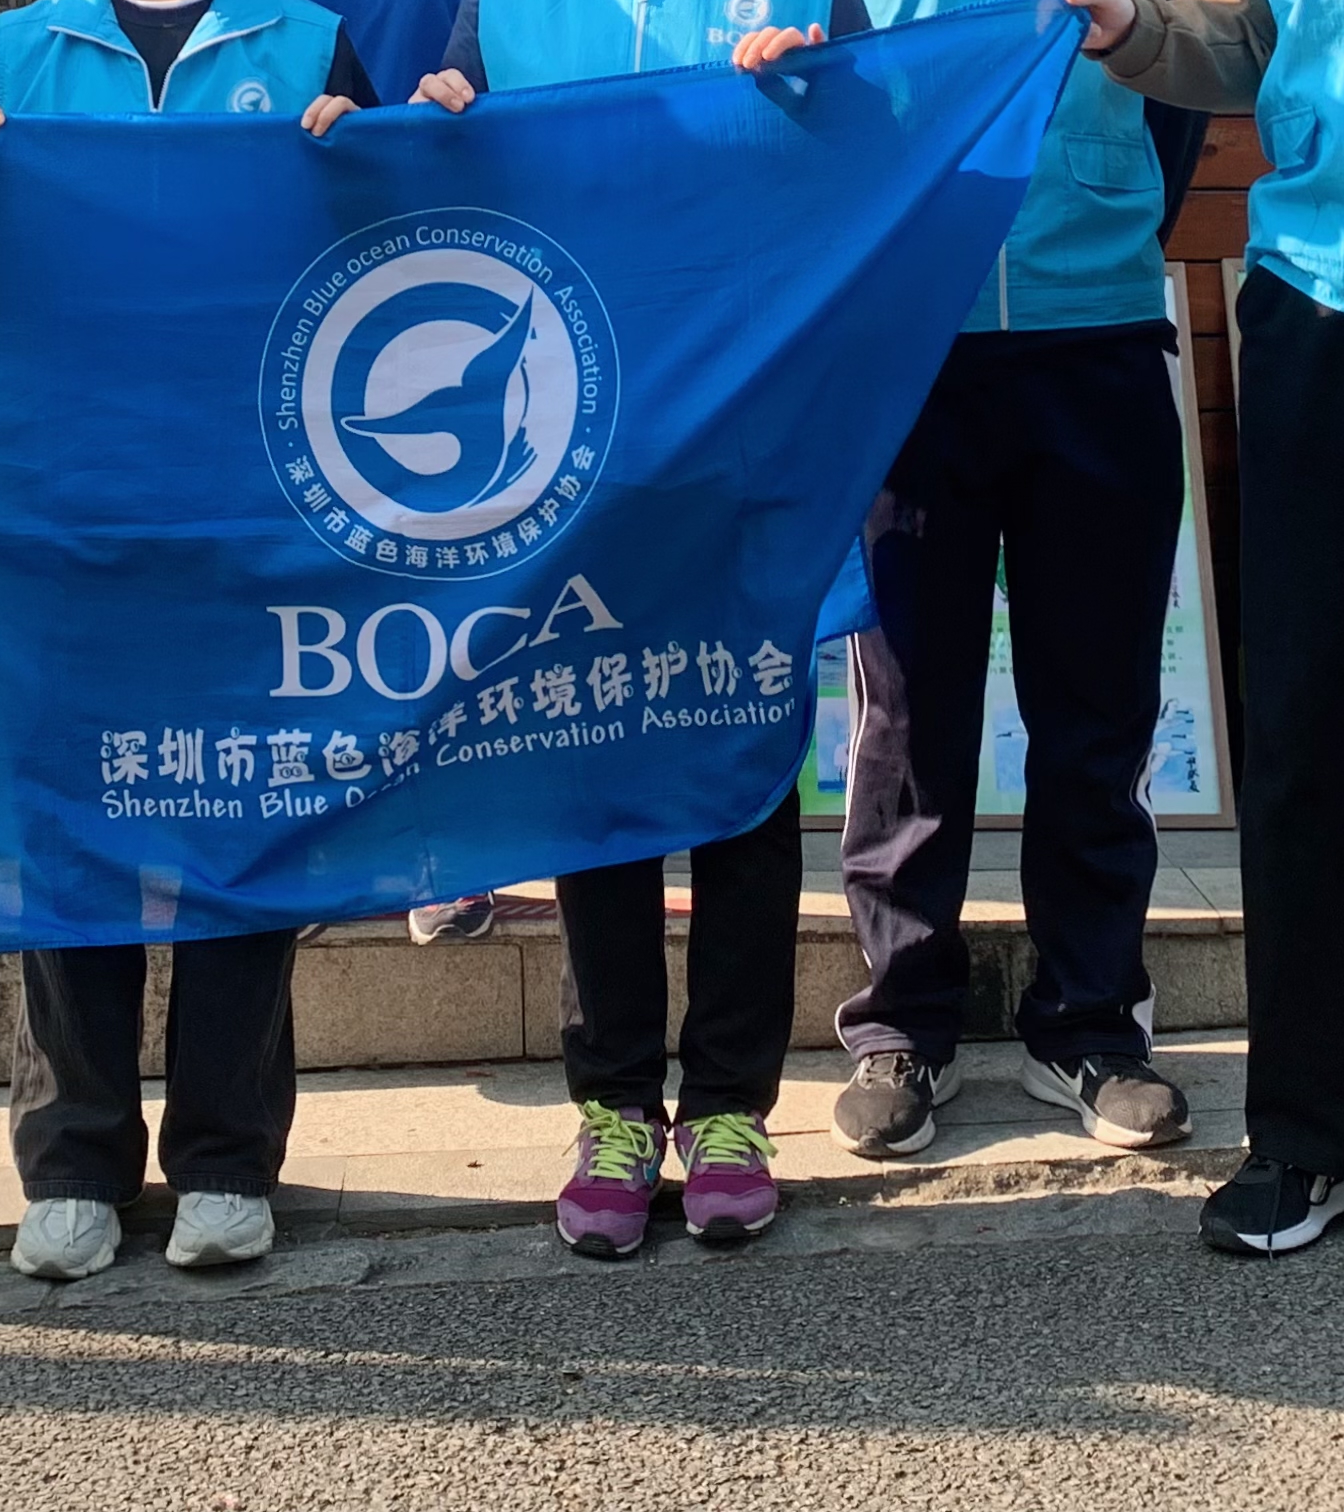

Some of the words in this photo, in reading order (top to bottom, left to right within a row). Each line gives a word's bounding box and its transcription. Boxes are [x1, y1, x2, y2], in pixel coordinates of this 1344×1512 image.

[276, 318, 314, 430] Shenzhen
[303, 271, 347, 316] Blue
[415, 226, 553, 284] Conservation
[554, 285, 603, 414] Association
[285, 444, 596, 570] 深圳市蓝色海洋环境保护协会
[266, 573, 624, 701] BOCA
[100, 640, 793, 788] 深圳市蓝色海洋环境保护协会
[101, 788, 243, 819] Shenzhen
[259, 787, 329, 819] Blue
[436, 718, 624, 767] Conservation
[641, 697, 795, 734] Association
